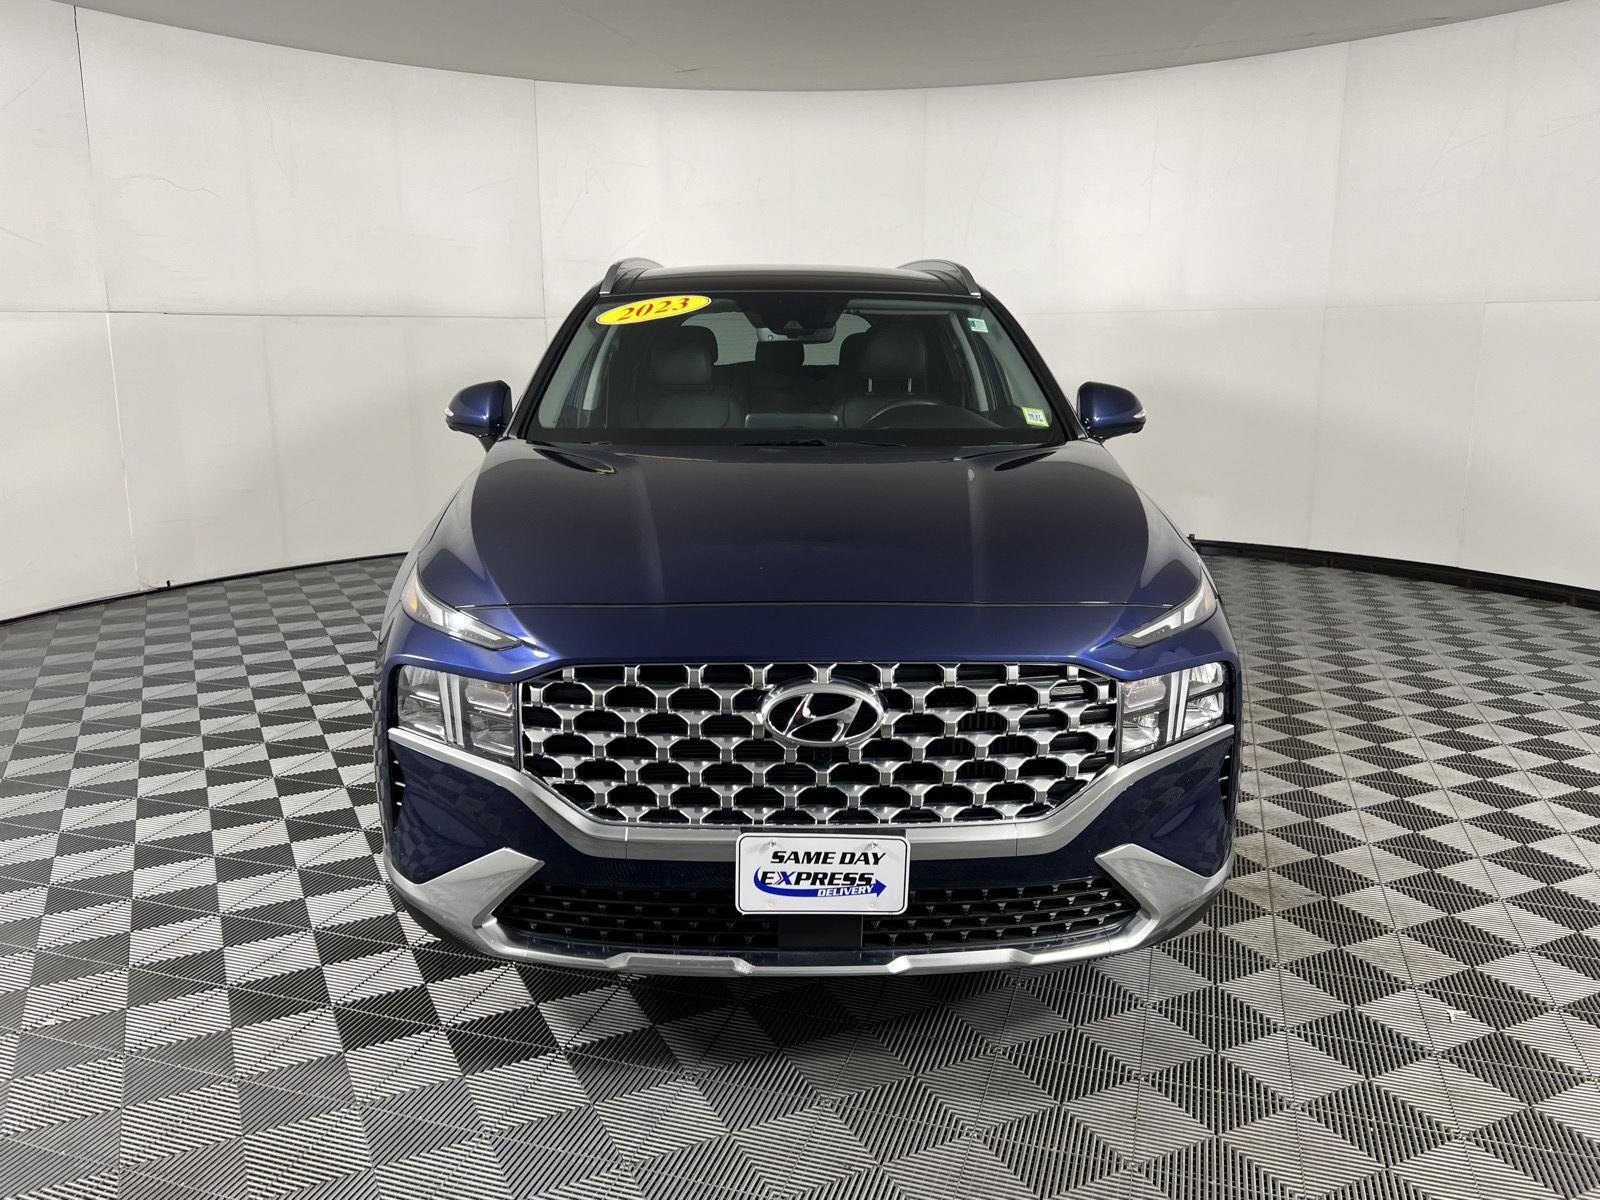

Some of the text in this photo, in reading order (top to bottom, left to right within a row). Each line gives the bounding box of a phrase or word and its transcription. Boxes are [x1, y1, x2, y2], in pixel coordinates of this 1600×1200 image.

[617, 297, 689, 321] 2023
[770, 850, 886, 866] SAME DAY
[760, 870, 874, 886] EXPRESS
[816, 884, 874, 897] DELIVERY
